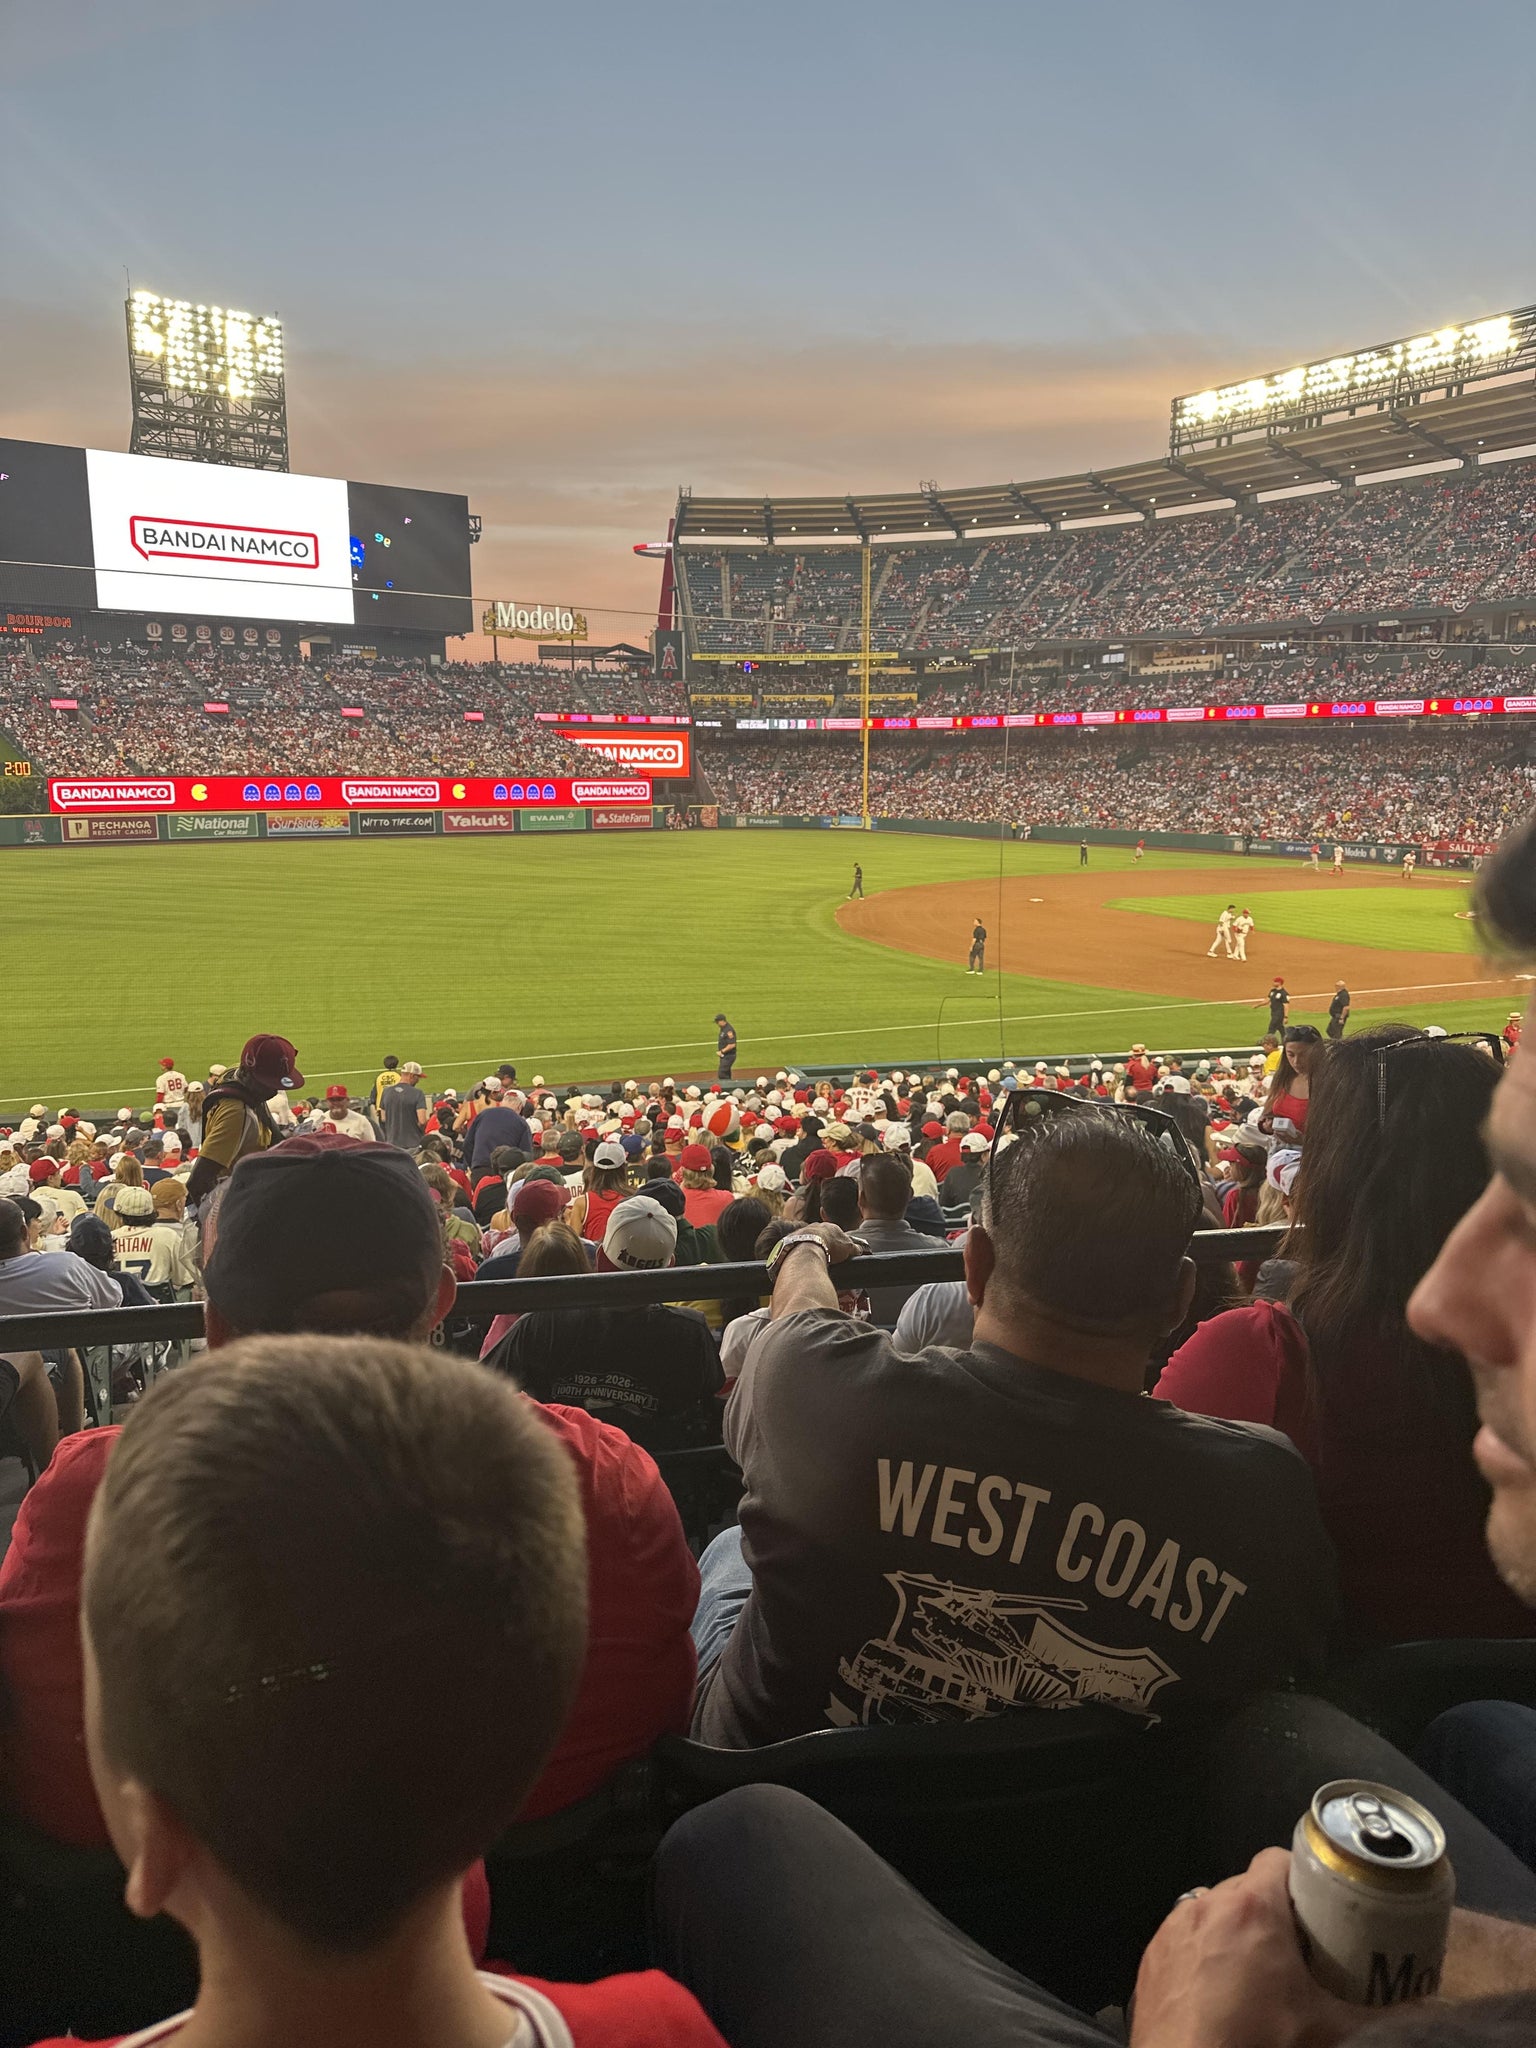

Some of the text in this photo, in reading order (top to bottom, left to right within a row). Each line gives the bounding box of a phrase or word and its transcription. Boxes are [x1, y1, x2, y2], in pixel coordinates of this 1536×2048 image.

[143, 528, 308, 557] BANDAI NAMCO
[7, 614, 72, 628] BOURBON
[497, 602, 573, 631] Modelo
[150, 625, 158, 634] 11
[198, 627, 210, 636] 29
[222, 628, 233, 638] 30
[245, 629, 256, 639] 42
[268, 631, 279, 640] 50
[620, 748, 676, 760] NAMCO
[4, 762, 31, 776] 2:00
[61, 787, 168, 800] BANDAI NAMCO
[348, 787, 434, 797] BANDAI NAMCO
[577, 786, 646, 796] BANDAI NAMCO
[92, 820, 151, 830] PECHANGA
[194, 817, 249, 830] National
[272, 816, 320, 830] Surfside
[362, 817, 433, 827] NITTO TIRE.COM
[448, 815, 509, 827] Yakult
[115, 1237, 153, 1253] HTANI
[617, 1248, 664, 1268] ANGELS
[575, 1374, 598, 1385] 1926
[605, 1374, 630, 1388] 2026
[583, 1387, 648, 1405] ANNIVERSARY
[877, 1458, 1248, 1643] WEST COAST
